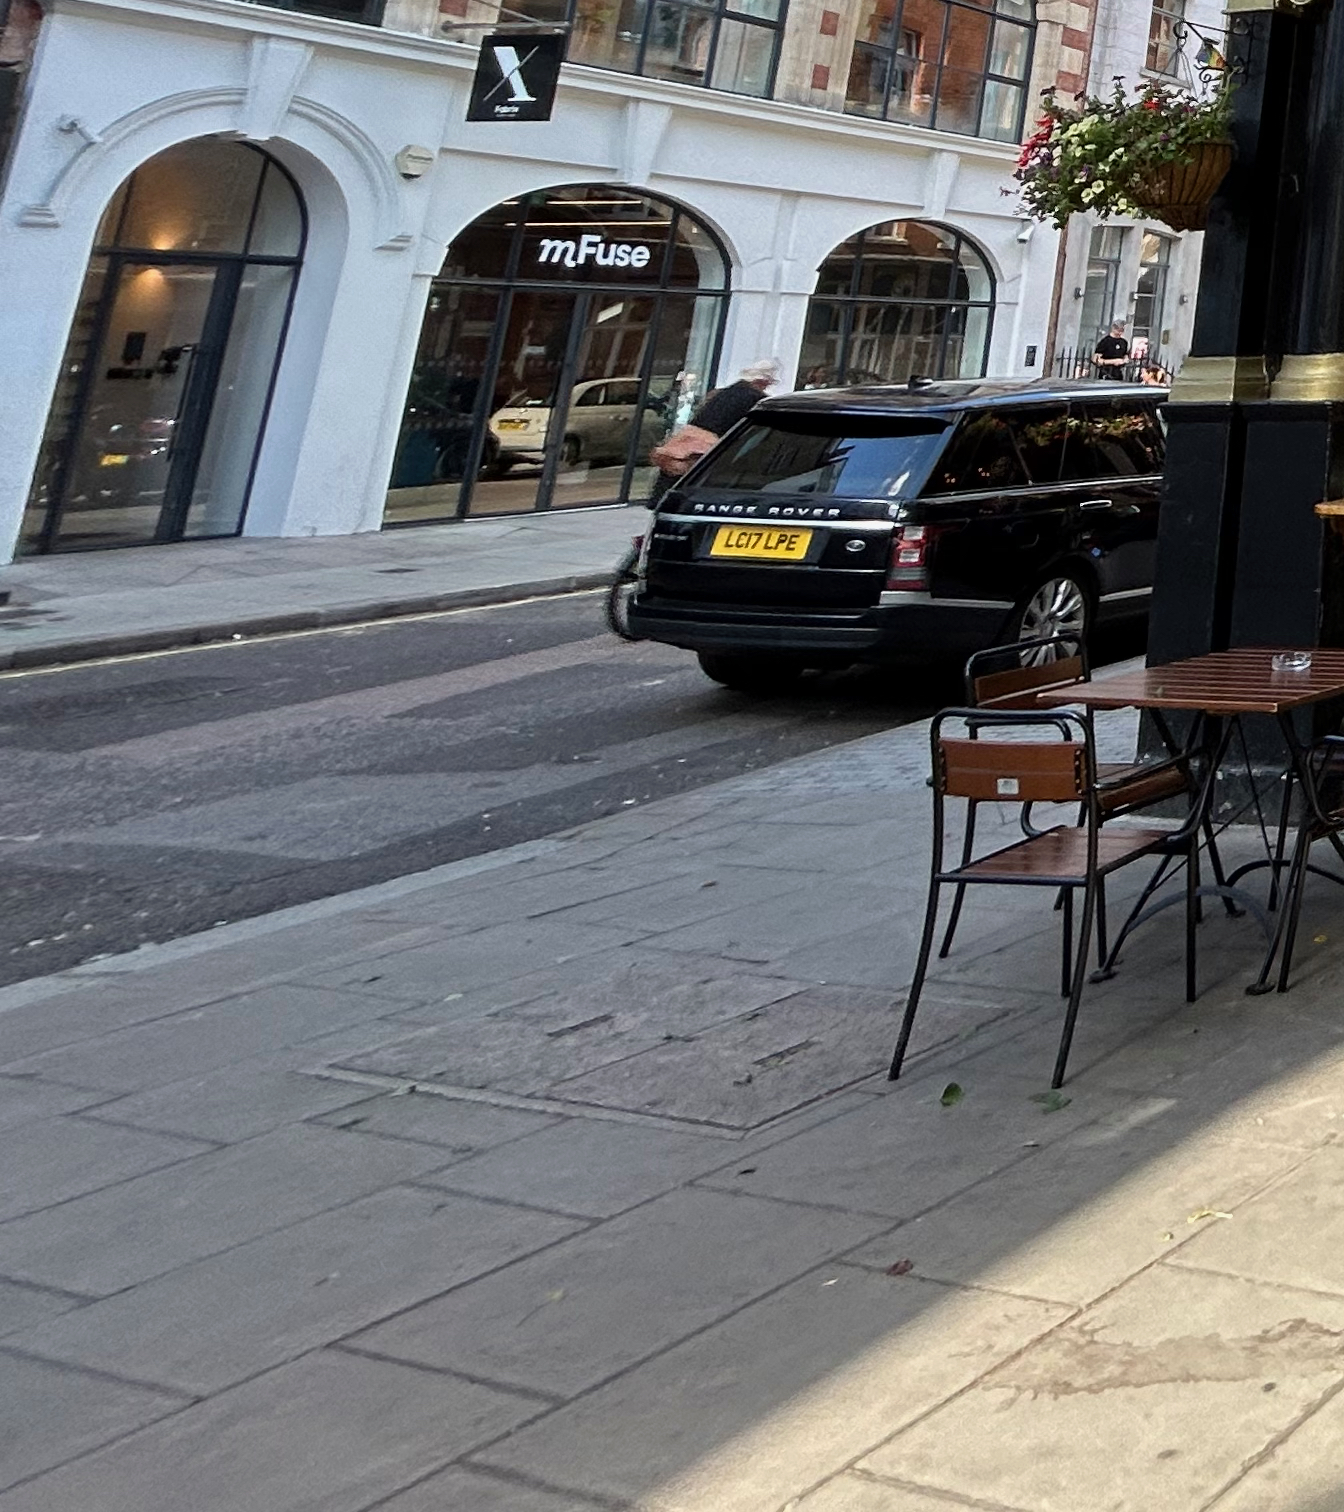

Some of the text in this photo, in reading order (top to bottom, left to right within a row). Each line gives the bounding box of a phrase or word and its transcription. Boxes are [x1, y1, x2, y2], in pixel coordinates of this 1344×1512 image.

[538, 234, 651, 268] mFuse
[693, 503, 841, 517] RANGE ROVER
[724, 530, 800, 551] LC17 LPE
